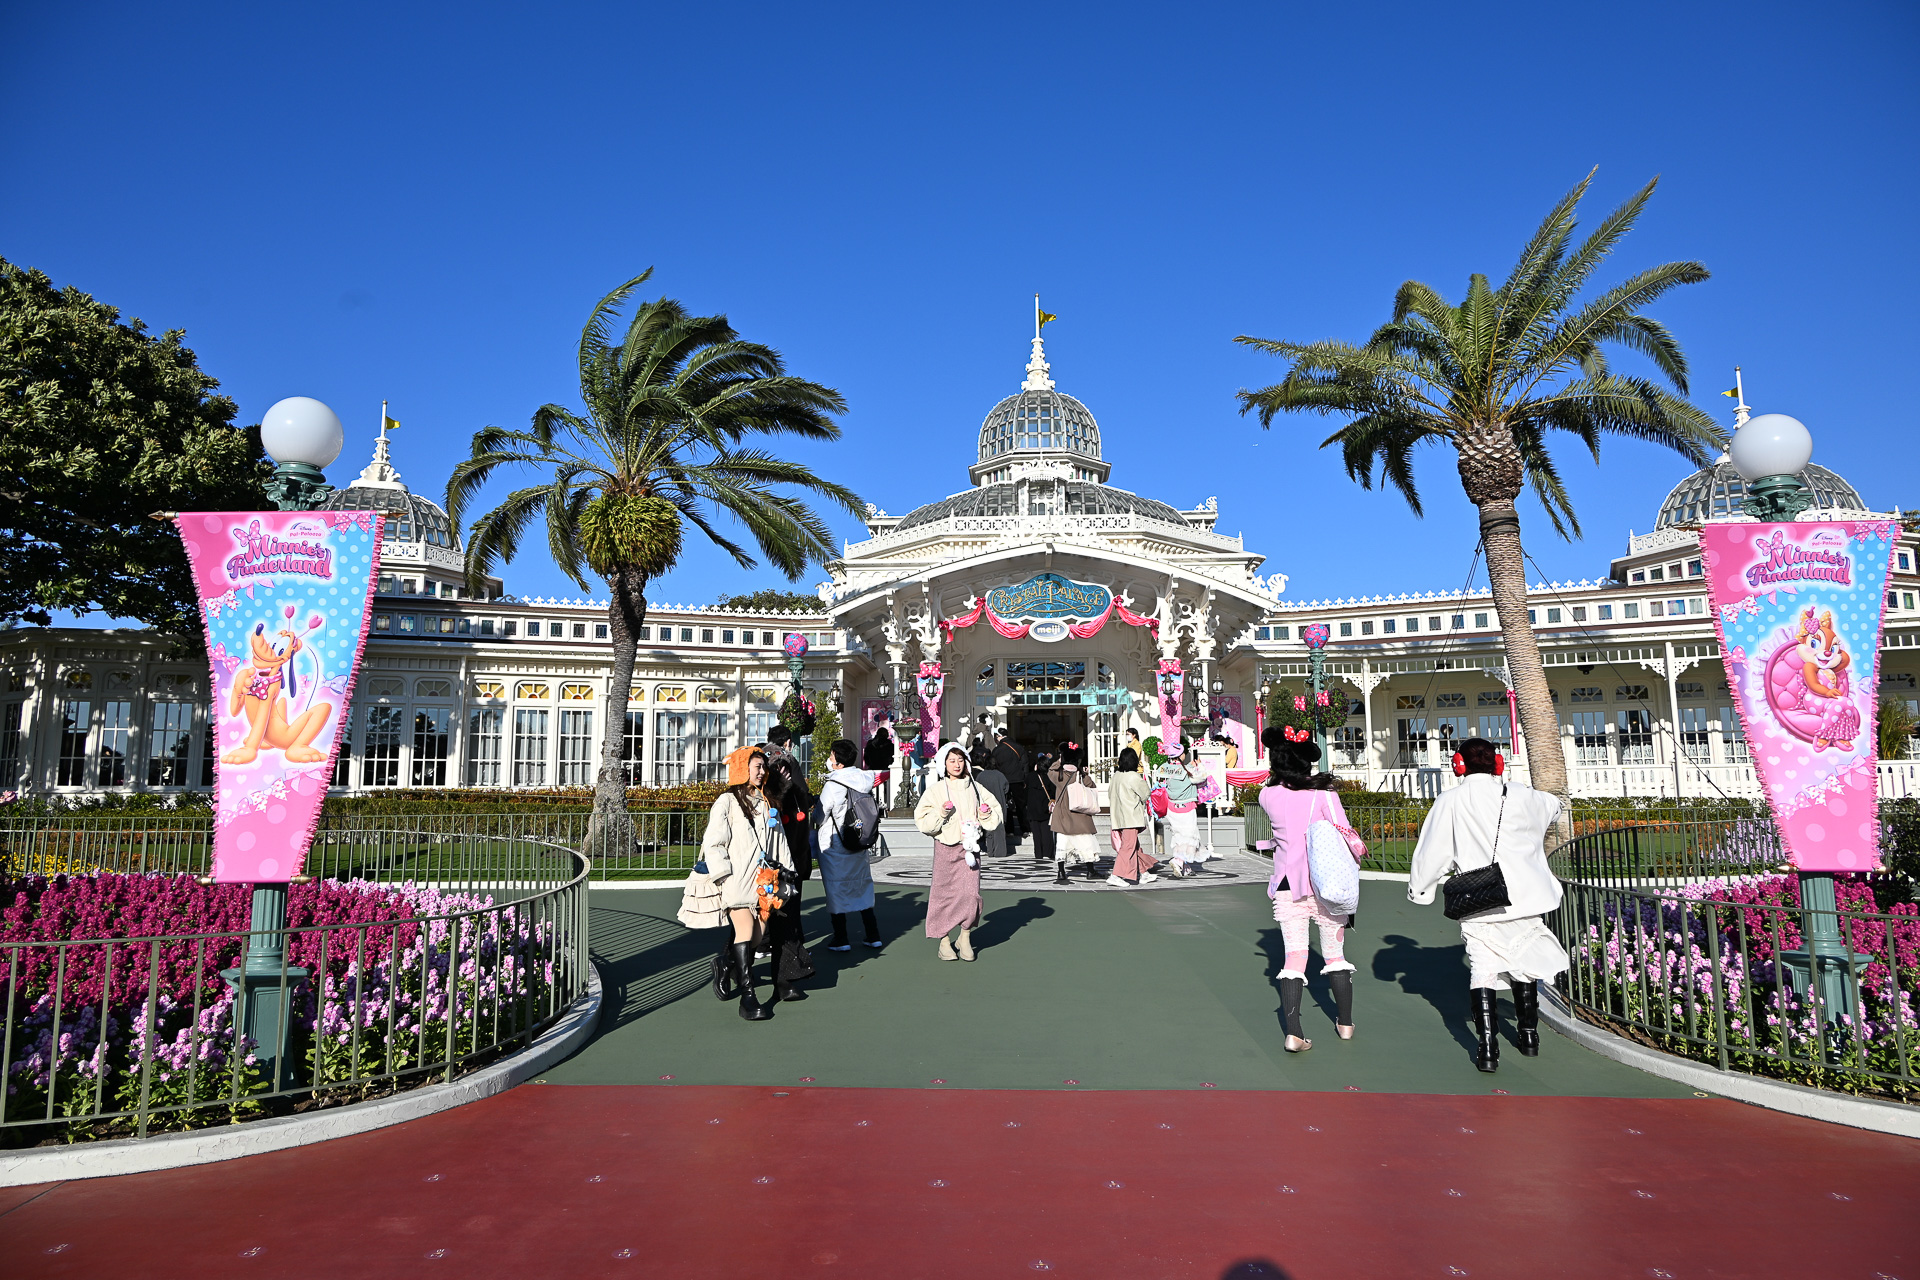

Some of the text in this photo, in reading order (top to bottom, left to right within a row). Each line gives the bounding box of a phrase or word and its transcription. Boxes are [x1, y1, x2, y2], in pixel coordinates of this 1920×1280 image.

[244, 534, 326, 564] Minnie's
[1766, 543, 1845, 572] Minnie's
[991, 579, 1105, 613] CRYSTAL PALACE
[1036, 624, 1061, 635] meiji
